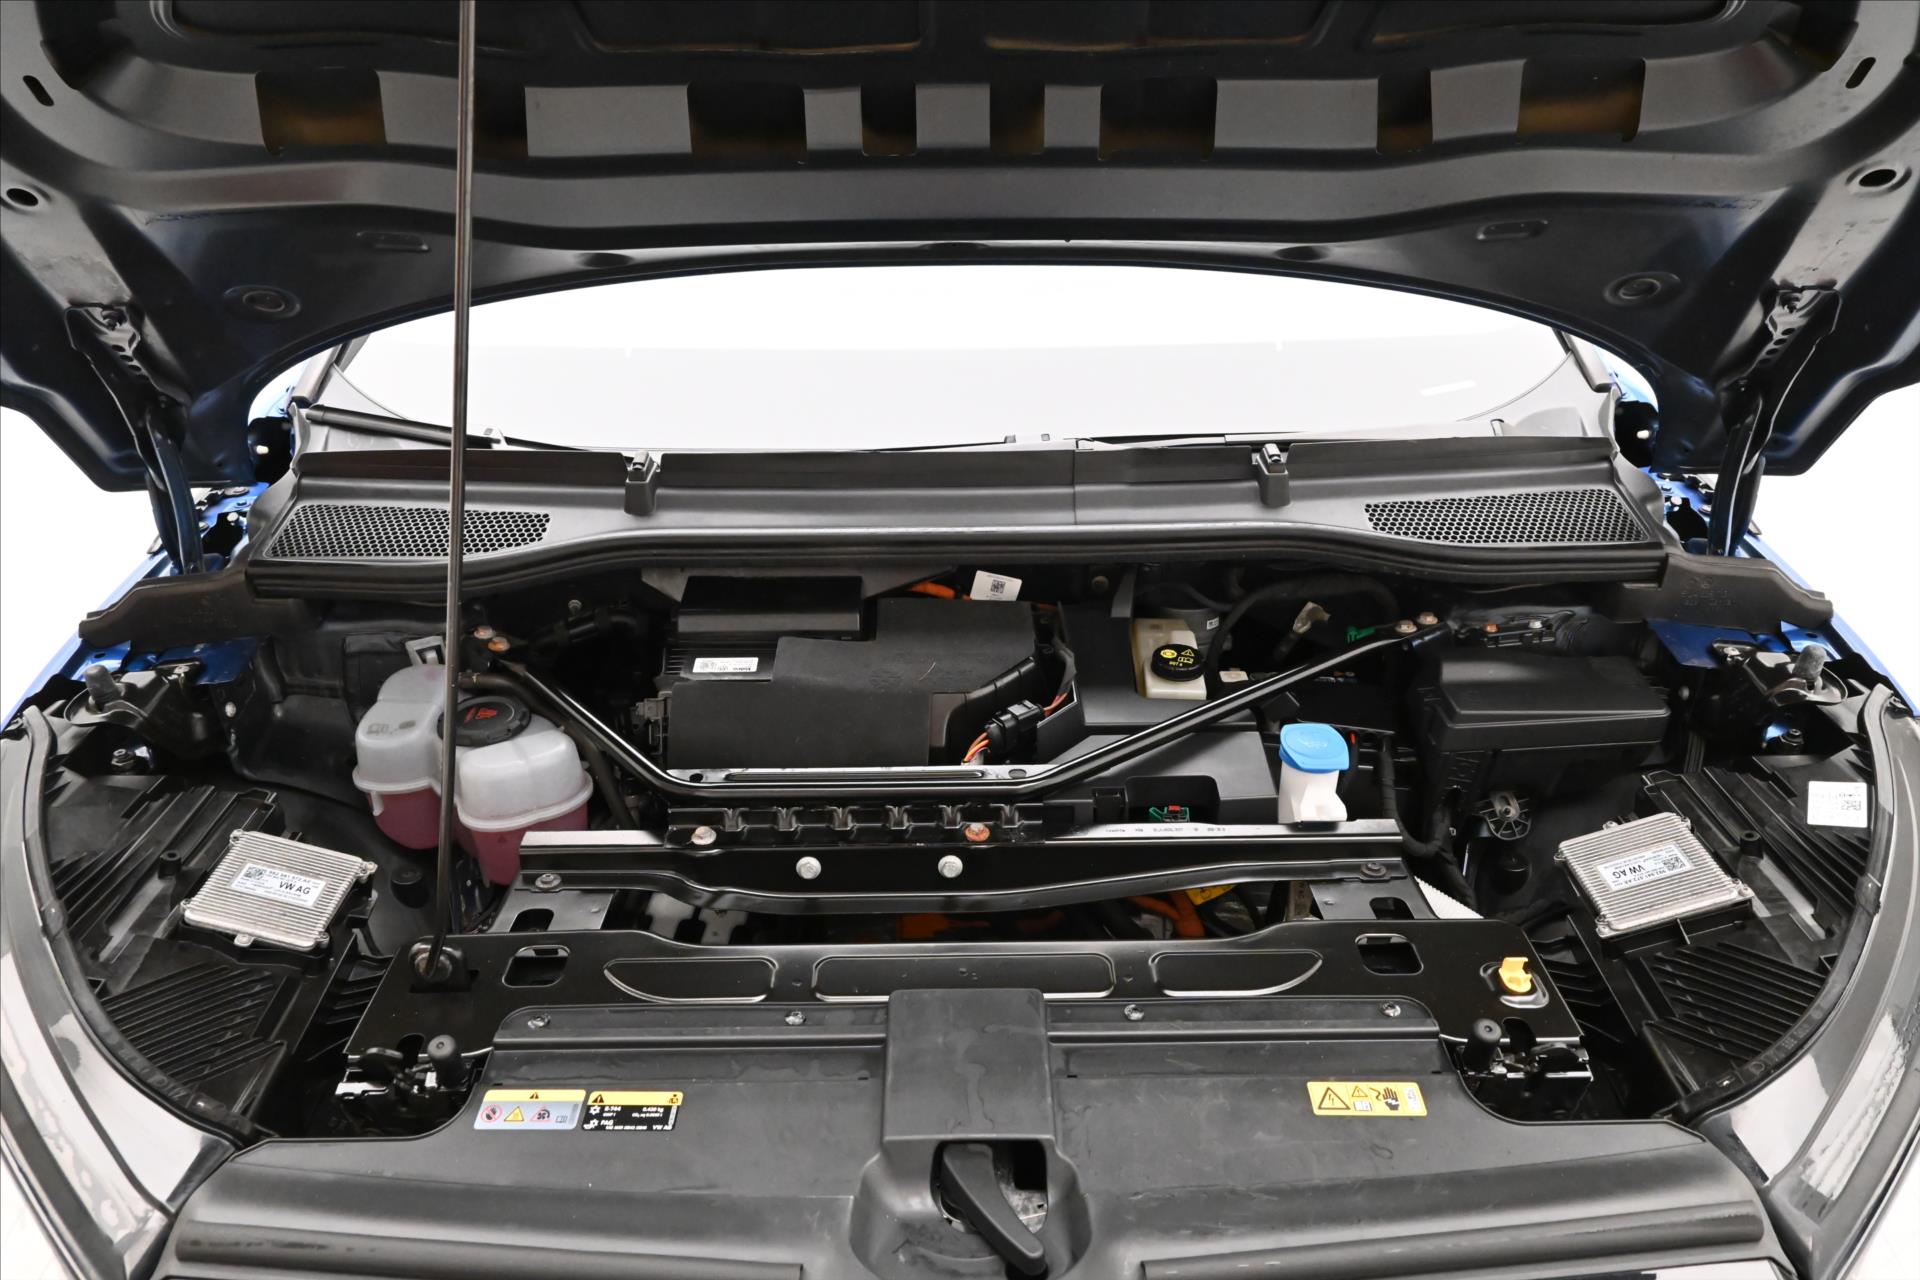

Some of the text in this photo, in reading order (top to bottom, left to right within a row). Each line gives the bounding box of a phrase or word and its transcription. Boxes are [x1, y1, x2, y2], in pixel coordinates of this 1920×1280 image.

[1612, 869, 1627, 878] AG
[1629, 865, 1644, 874] VW
[279, 881, 294, 890] VW
[295, 886, 310, 894] AG
